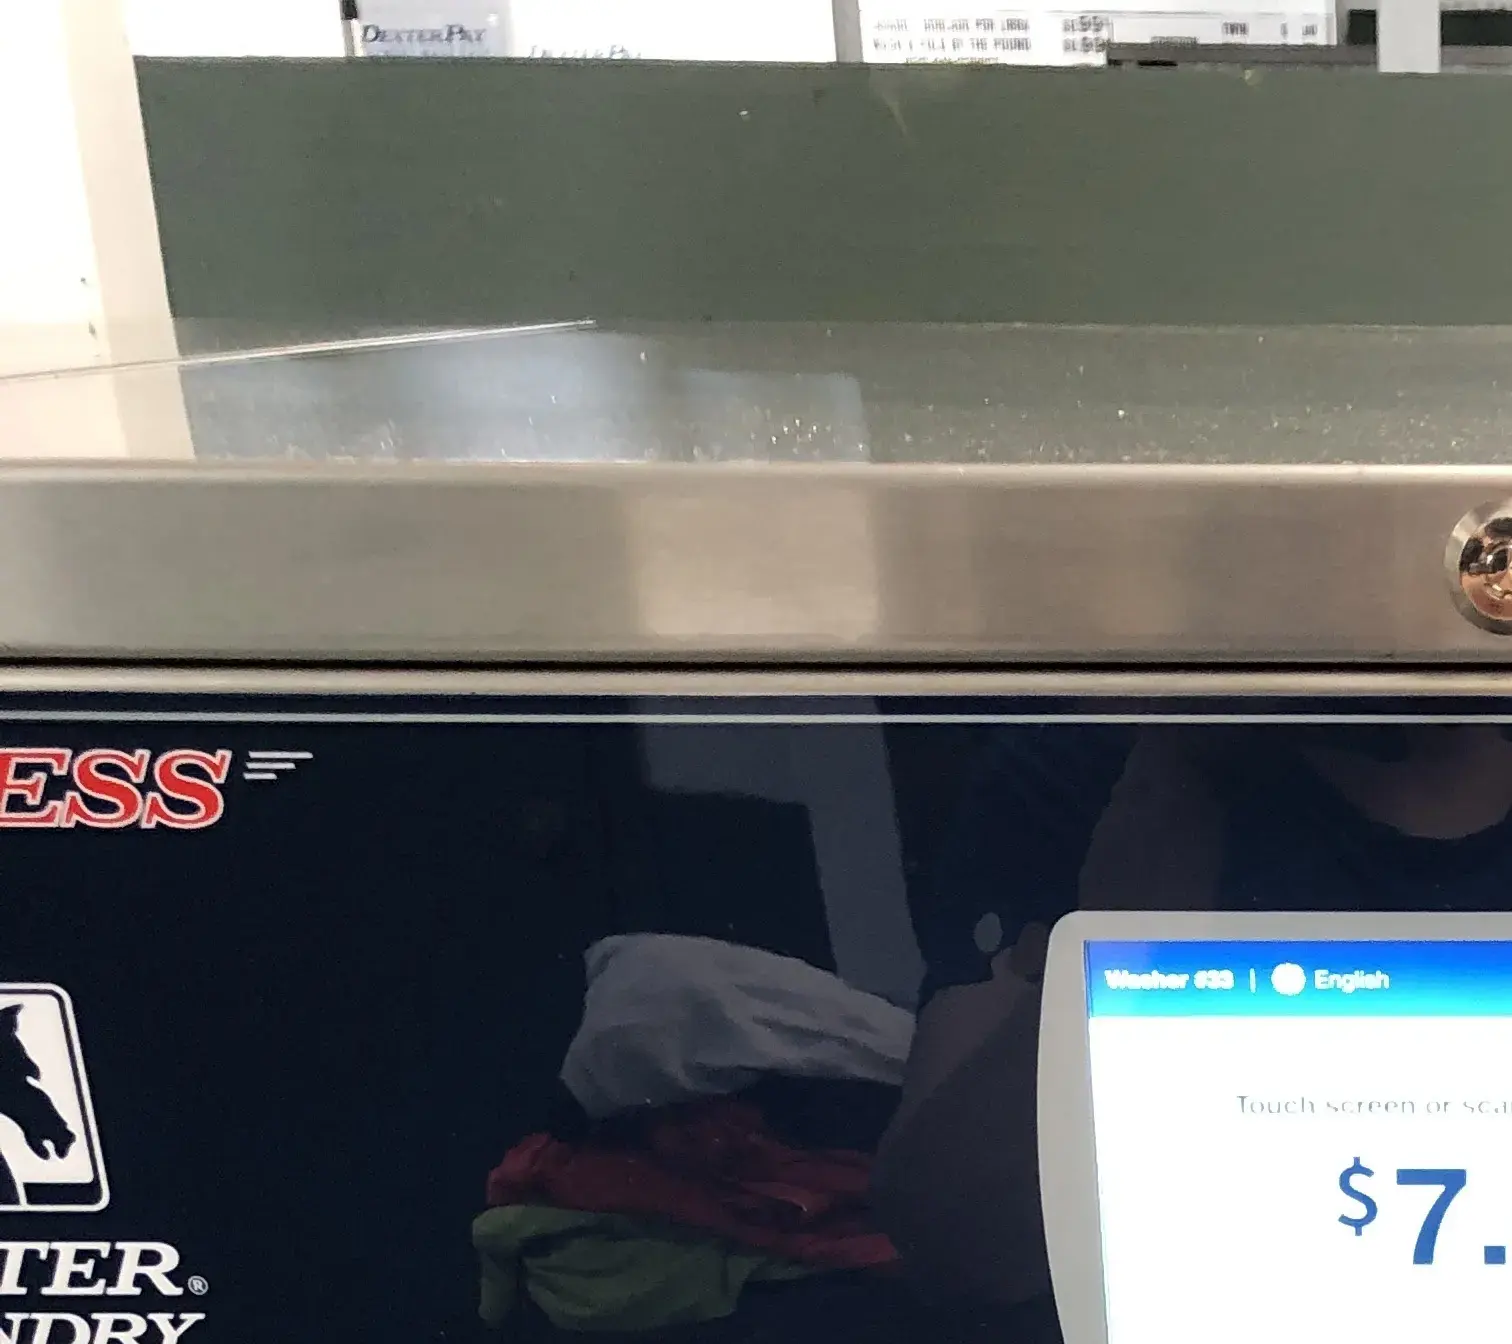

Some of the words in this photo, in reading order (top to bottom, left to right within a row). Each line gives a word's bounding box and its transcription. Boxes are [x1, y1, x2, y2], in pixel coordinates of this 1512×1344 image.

[0, 748, 233, 829] ESS
[1104, 969, 1190, 990] Washer
[1314, 969, 1390, 993] English
[1236, 1095, 1315, 1113] Touch
[1326, 1100, 1416, 1114] screen
[1425, 1100, 1452, 1114] or
